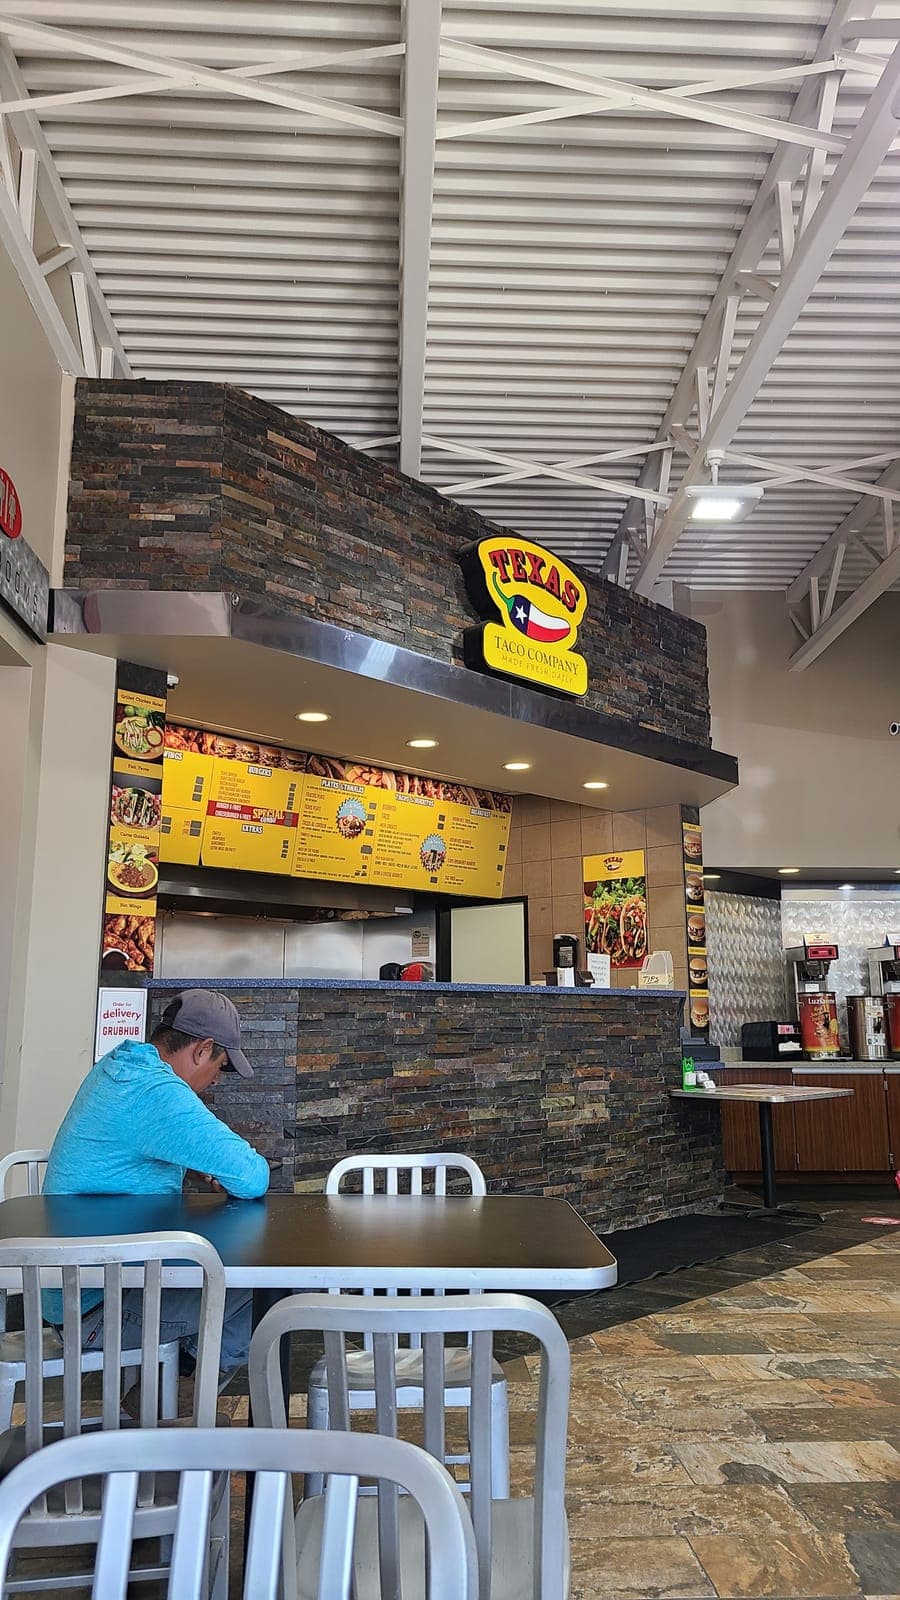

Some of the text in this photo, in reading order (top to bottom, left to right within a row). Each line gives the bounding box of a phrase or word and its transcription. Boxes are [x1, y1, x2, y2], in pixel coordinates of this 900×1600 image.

[488, 548, 580, 613] TEXAS
[494, 635, 579, 675] TACO COMPANY
[502, 654, 573, 684] MADE FRESH DAILY
[252, 808, 285, 820] SPECIAL
[102, 1008, 142, 1021] delivery
[102, 1026, 140, 1036] GRUBHUB
